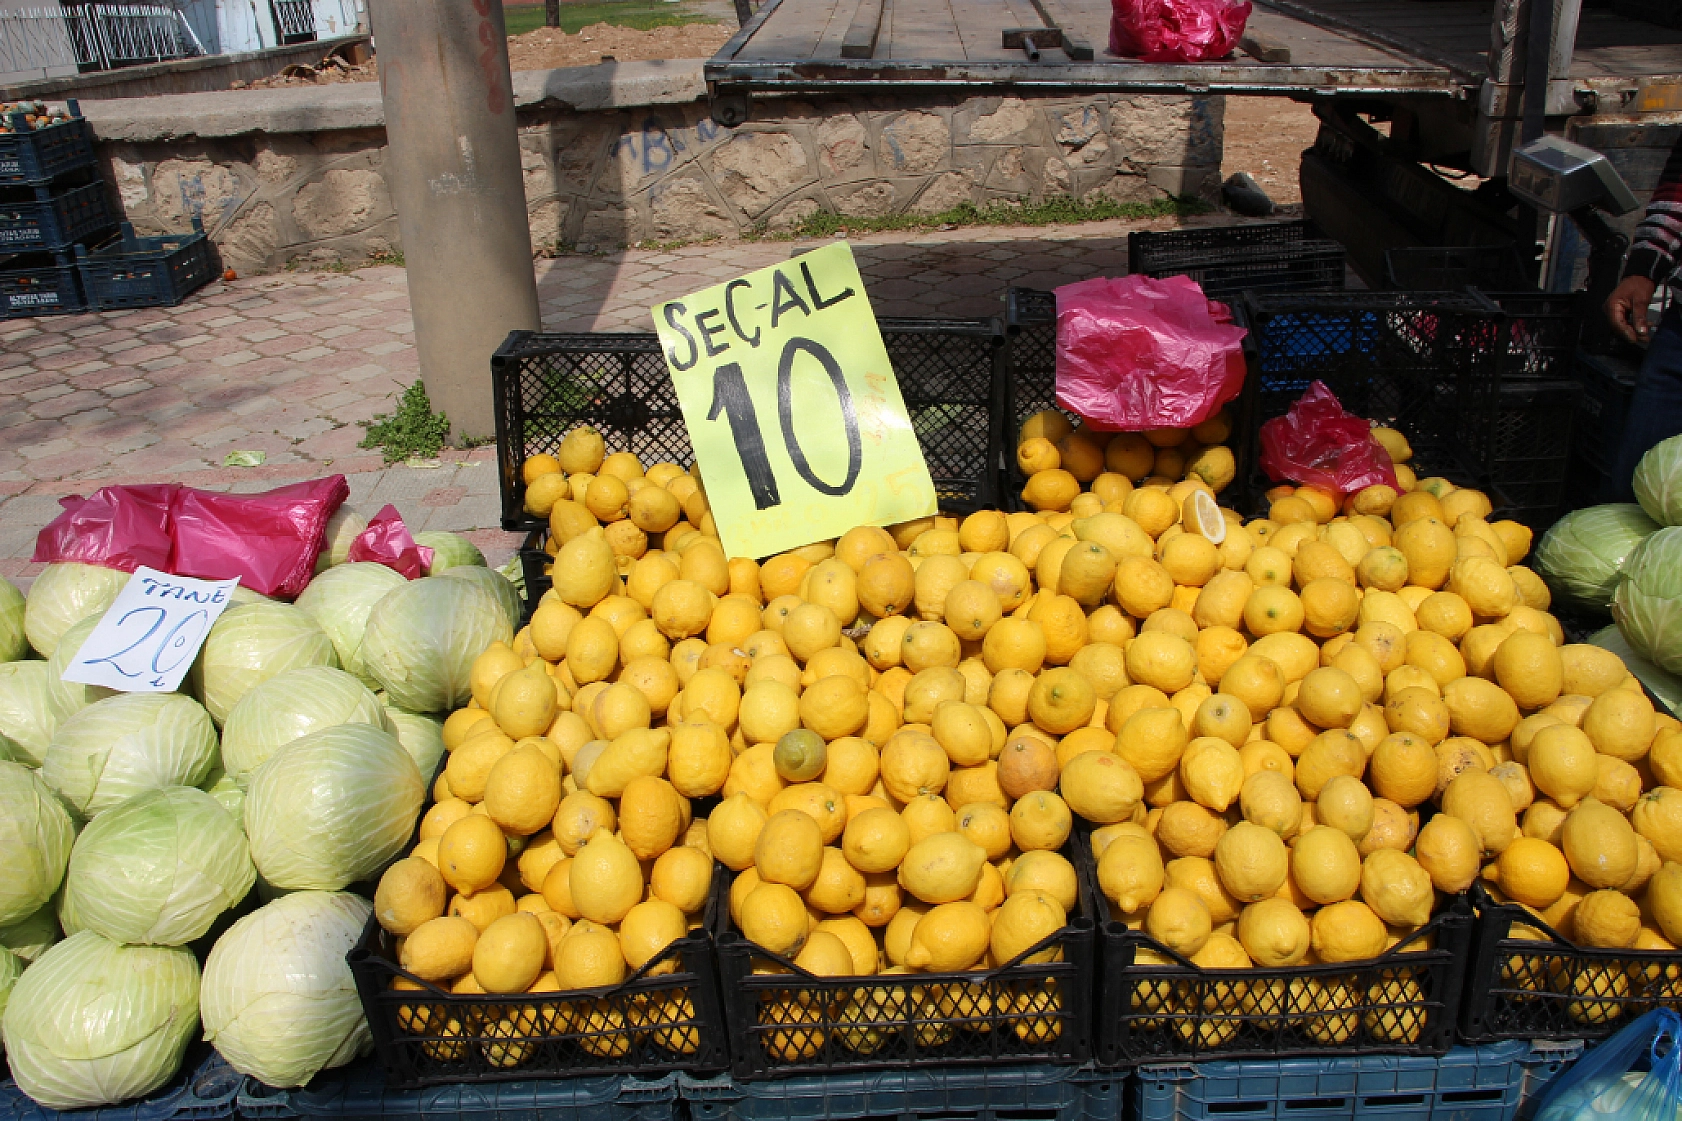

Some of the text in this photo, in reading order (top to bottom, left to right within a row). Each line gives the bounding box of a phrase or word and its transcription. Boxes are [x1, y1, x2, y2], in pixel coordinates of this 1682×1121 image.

[706, 336, 863, 511] 10
[141, 577, 233, 604] TANE
[82, 606, 209, 678] 20
